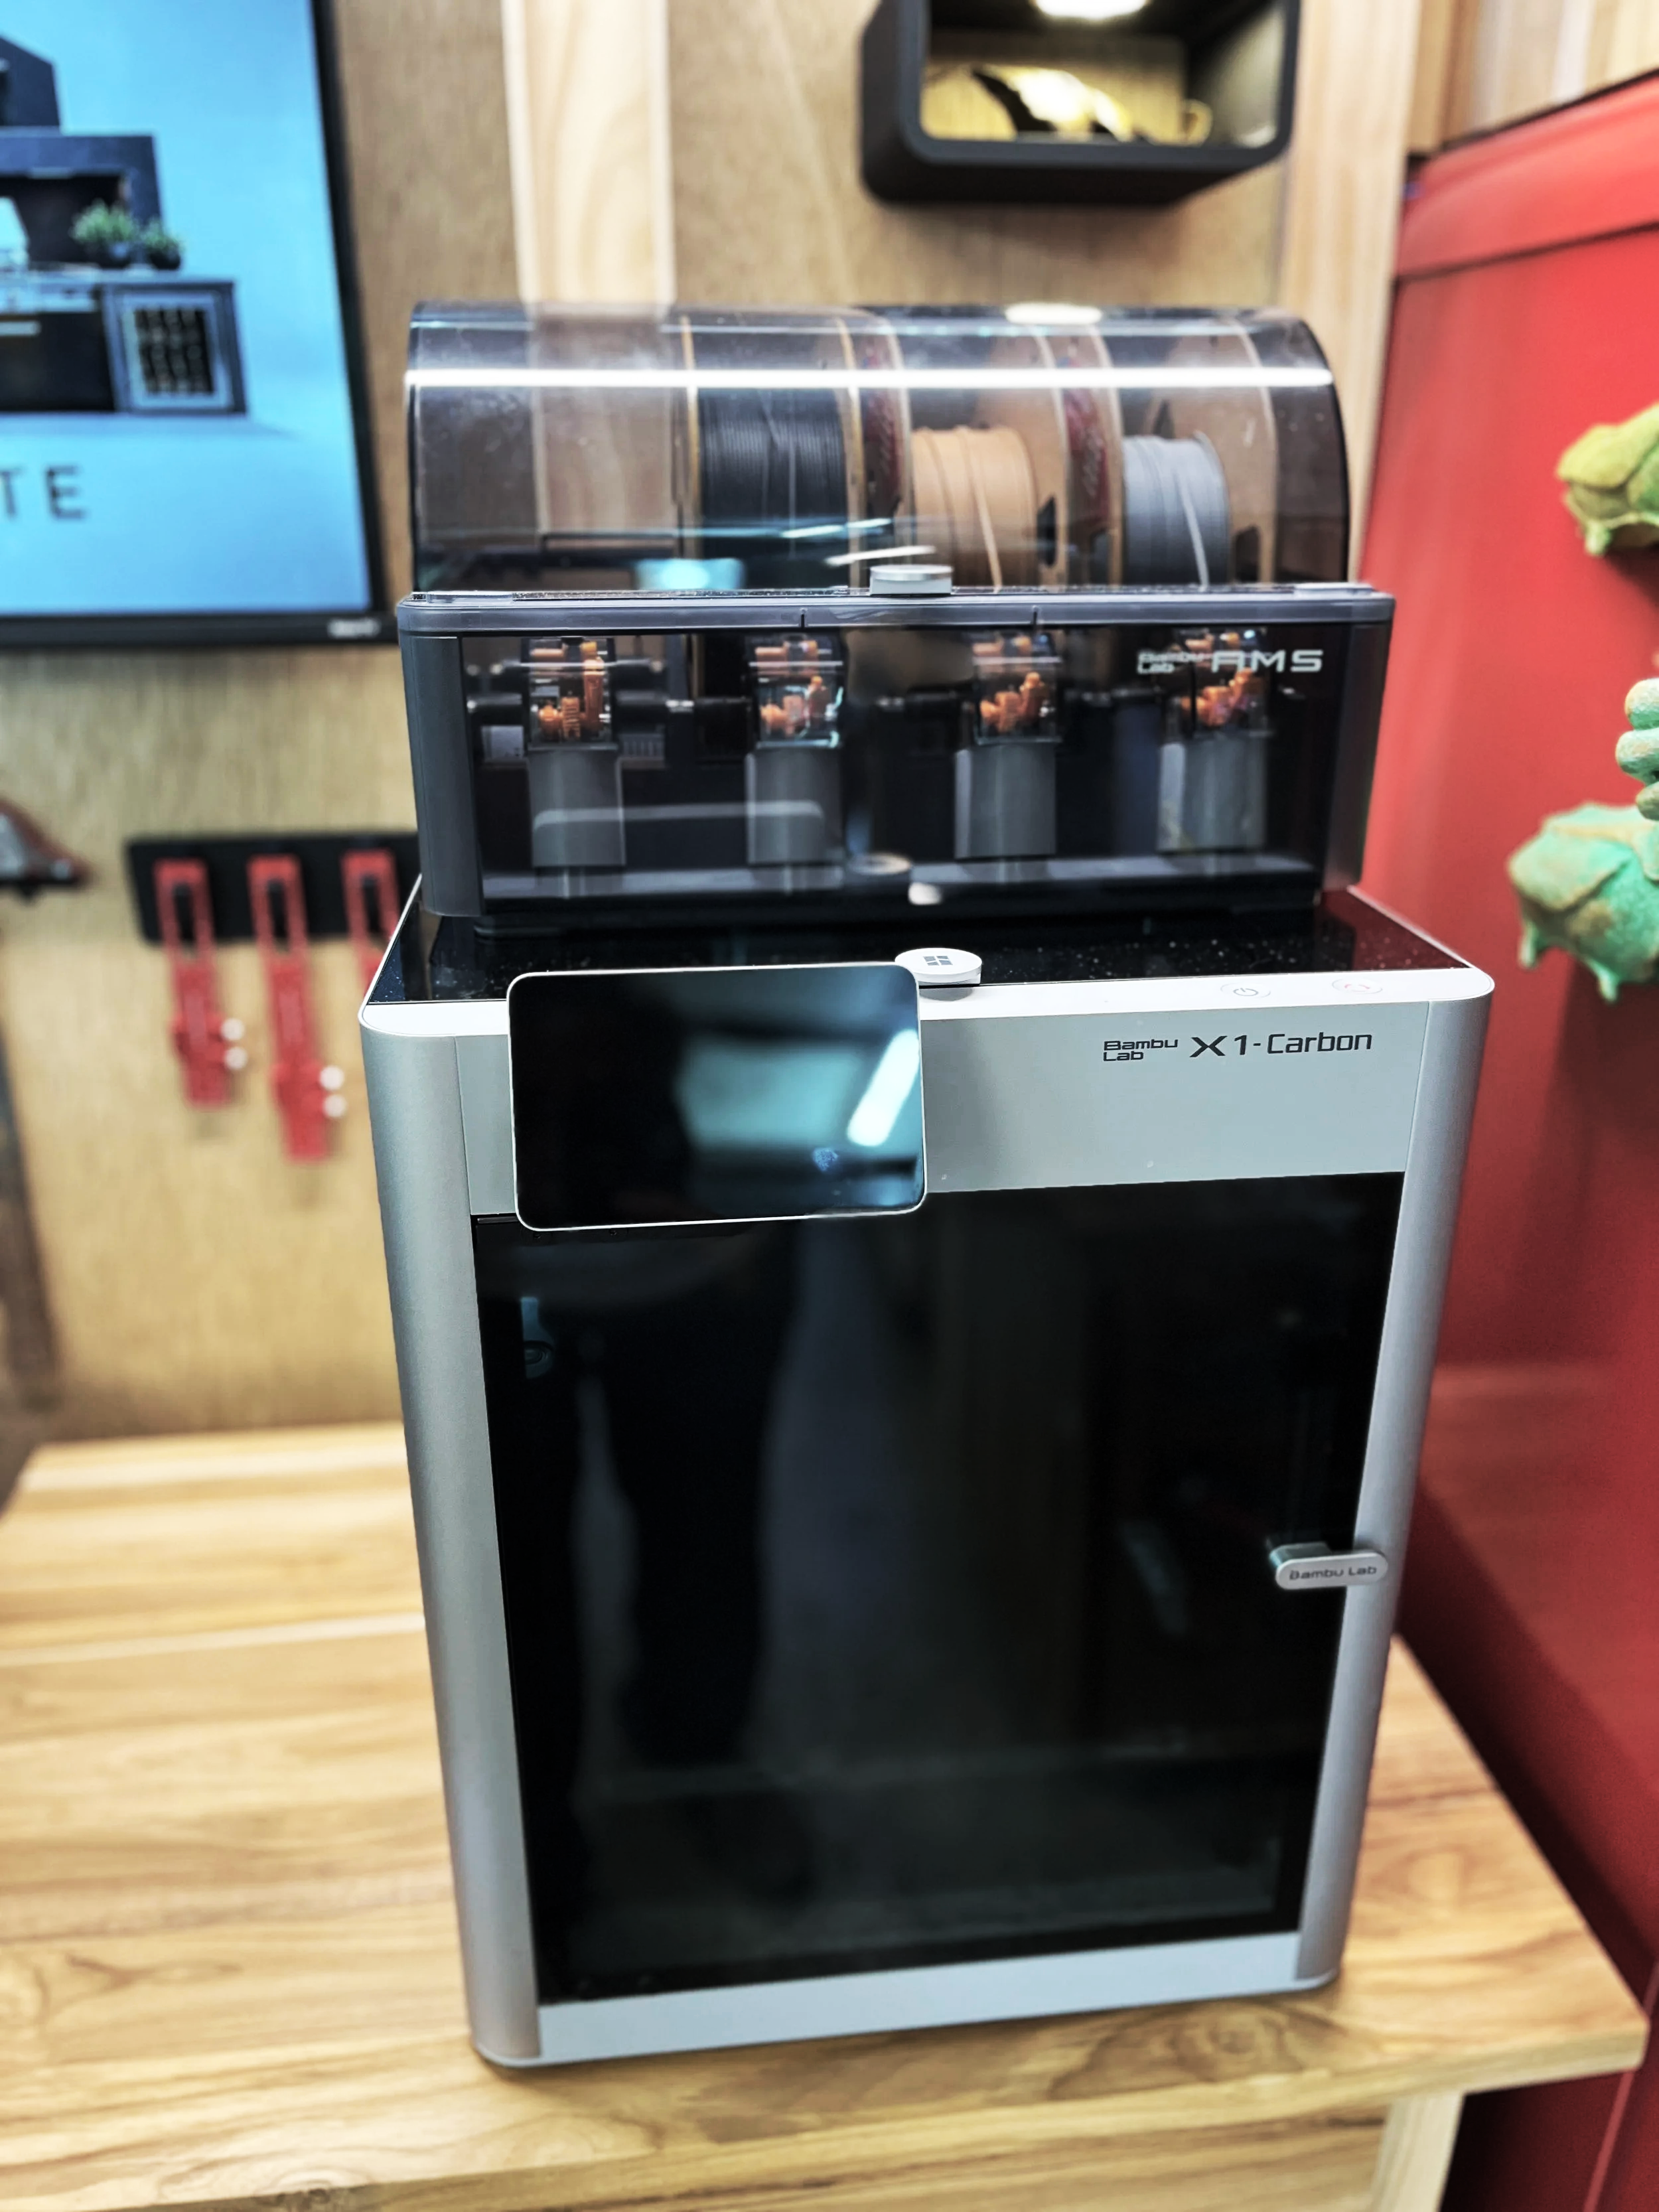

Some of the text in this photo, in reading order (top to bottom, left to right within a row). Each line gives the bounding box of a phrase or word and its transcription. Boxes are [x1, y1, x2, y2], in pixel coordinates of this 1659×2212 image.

[0, 463, 88, 522] TE
[1211, 650, 1323, 673] AMS
[1104, 1039, 1179, 1051] Bambu
[1104, 1051, 1144, 1062] Lab
[1289, 1566, 1377, 1580] Bambu Lab
